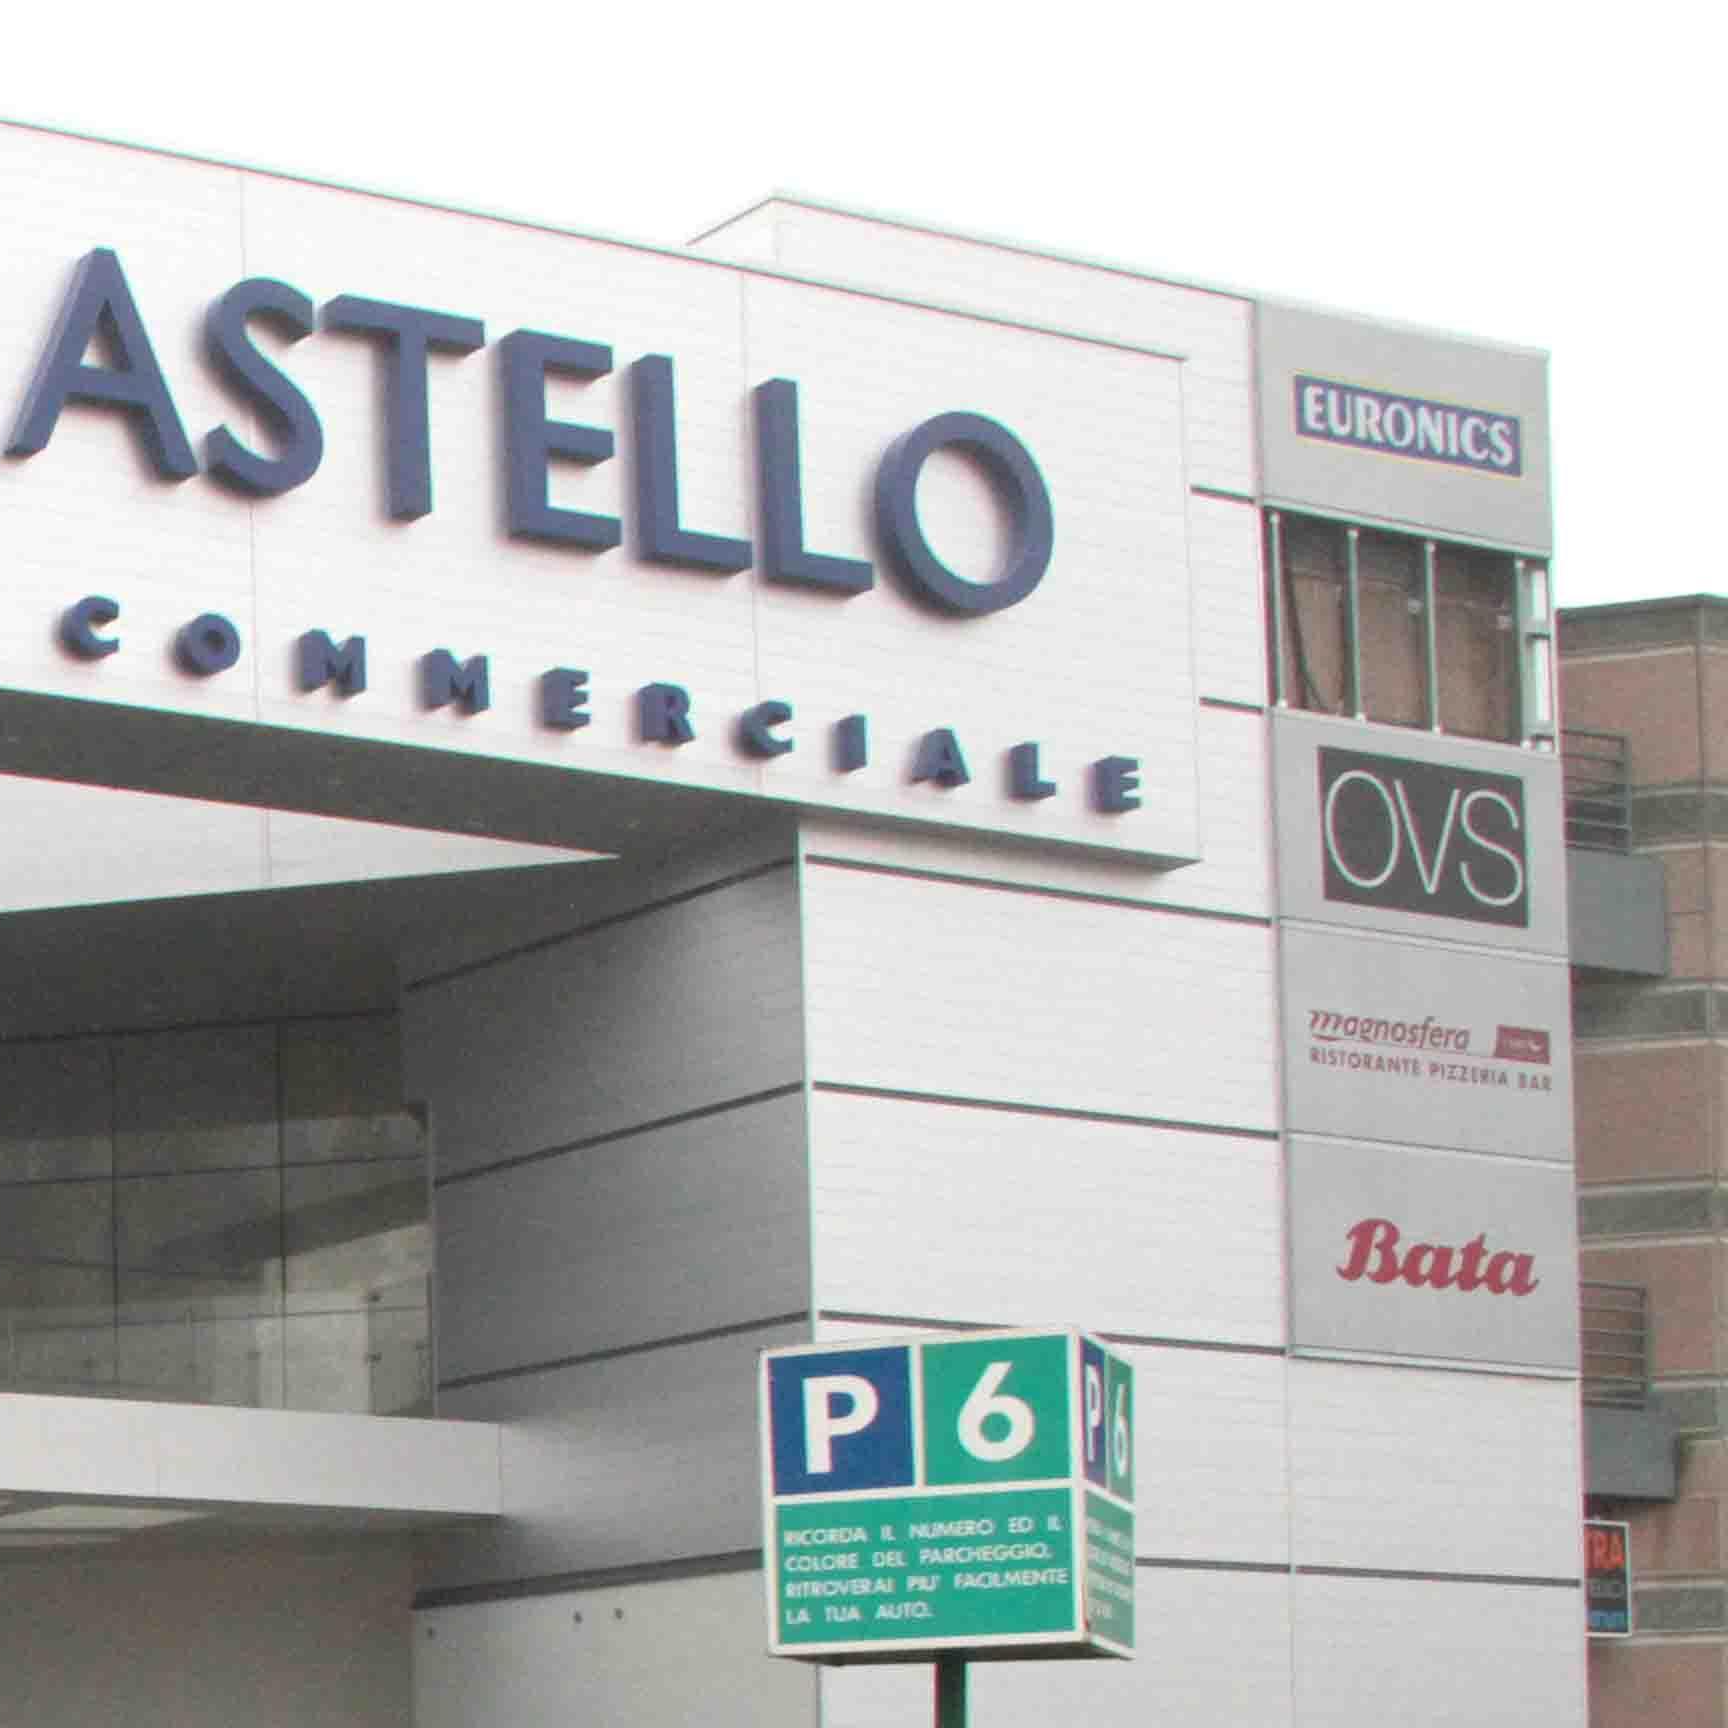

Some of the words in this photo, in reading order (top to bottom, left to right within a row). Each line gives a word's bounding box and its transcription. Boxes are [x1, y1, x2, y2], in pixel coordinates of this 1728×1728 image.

[1302, 384, 1514, 467] EURONICS
[59, 594, 1144, 814] COMMERCIALE
[1325, 769, 1524, 907] OVS
[1310, 1047, 1420, 1076] RISTORANTE
[1429, 1063, 1507, 1087] PIZZERIA
[1517, 1073, 1552, 1091] BAR
[1335, 1218, 1540, 1297] Bata
[802, 1374, 878, 1475] P
[957, 1361, 1035, 1463] 6
[784, 1528, 867, 1546] RICORDA
[909, 1519, 995, 1540] NUMERO
[1008, 1516, 1034, 1534] ED
[785, 1553, 859, 1573] COLORE
[872, 1551, 906, 1568] DEL
[785, 1577, 895, 1598] RITROVERAI
[954, 1568, 1070, 1590] FACILMENTE
[785, 1608, 811, 1624] LA
[825, 1604, 862, 1623] TUA
